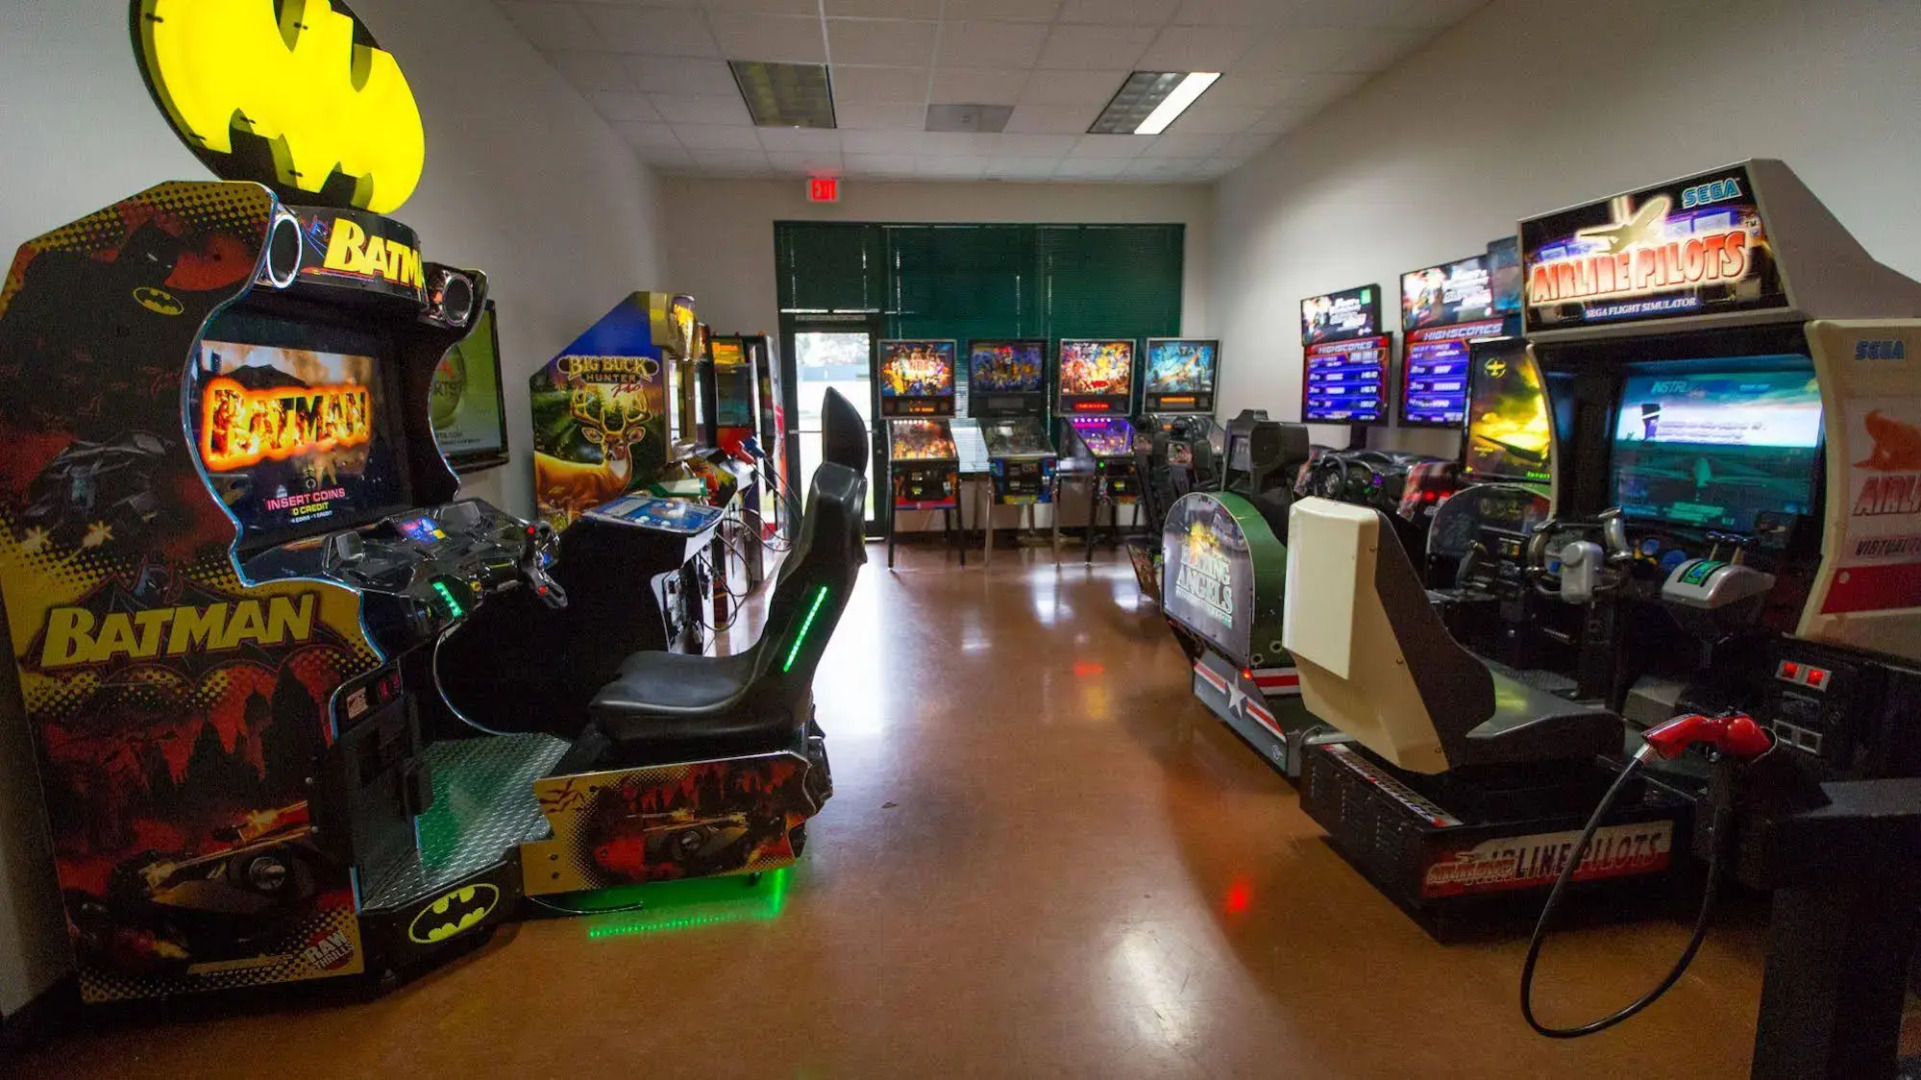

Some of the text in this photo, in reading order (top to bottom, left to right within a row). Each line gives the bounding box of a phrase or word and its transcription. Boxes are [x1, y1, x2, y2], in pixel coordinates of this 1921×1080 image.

[1682, 177, 1743, 210] SEGA
[1532, 252, 1631, 304] AIRLINE
[1637, 229, 1748, 290] PILOTS
[1586, 297, 1698, 319] SEGA FLIGHT SIMULATOR
[1422, 322, 1504, 342] HIGHSCORES
[1855, 340, 1905, 360] SEGA
[568, 356, 651, 378] BIG BUCK
[586, 374, 636, 383] HUNTER
[208, 384, 368, 456] BATMAN
[267, 487, 346, 512] INSERT COINS
[300, 502, 329, 515] CREDIT
[1176, 564, 1233, 615] ANGELS
[40, 593, 315, 668] BATMAN
[1577, 832, 1662, 874] PILOTS
[303, 929, 348, 963] RAW
[313, 942, 355, 970] THRILLS
